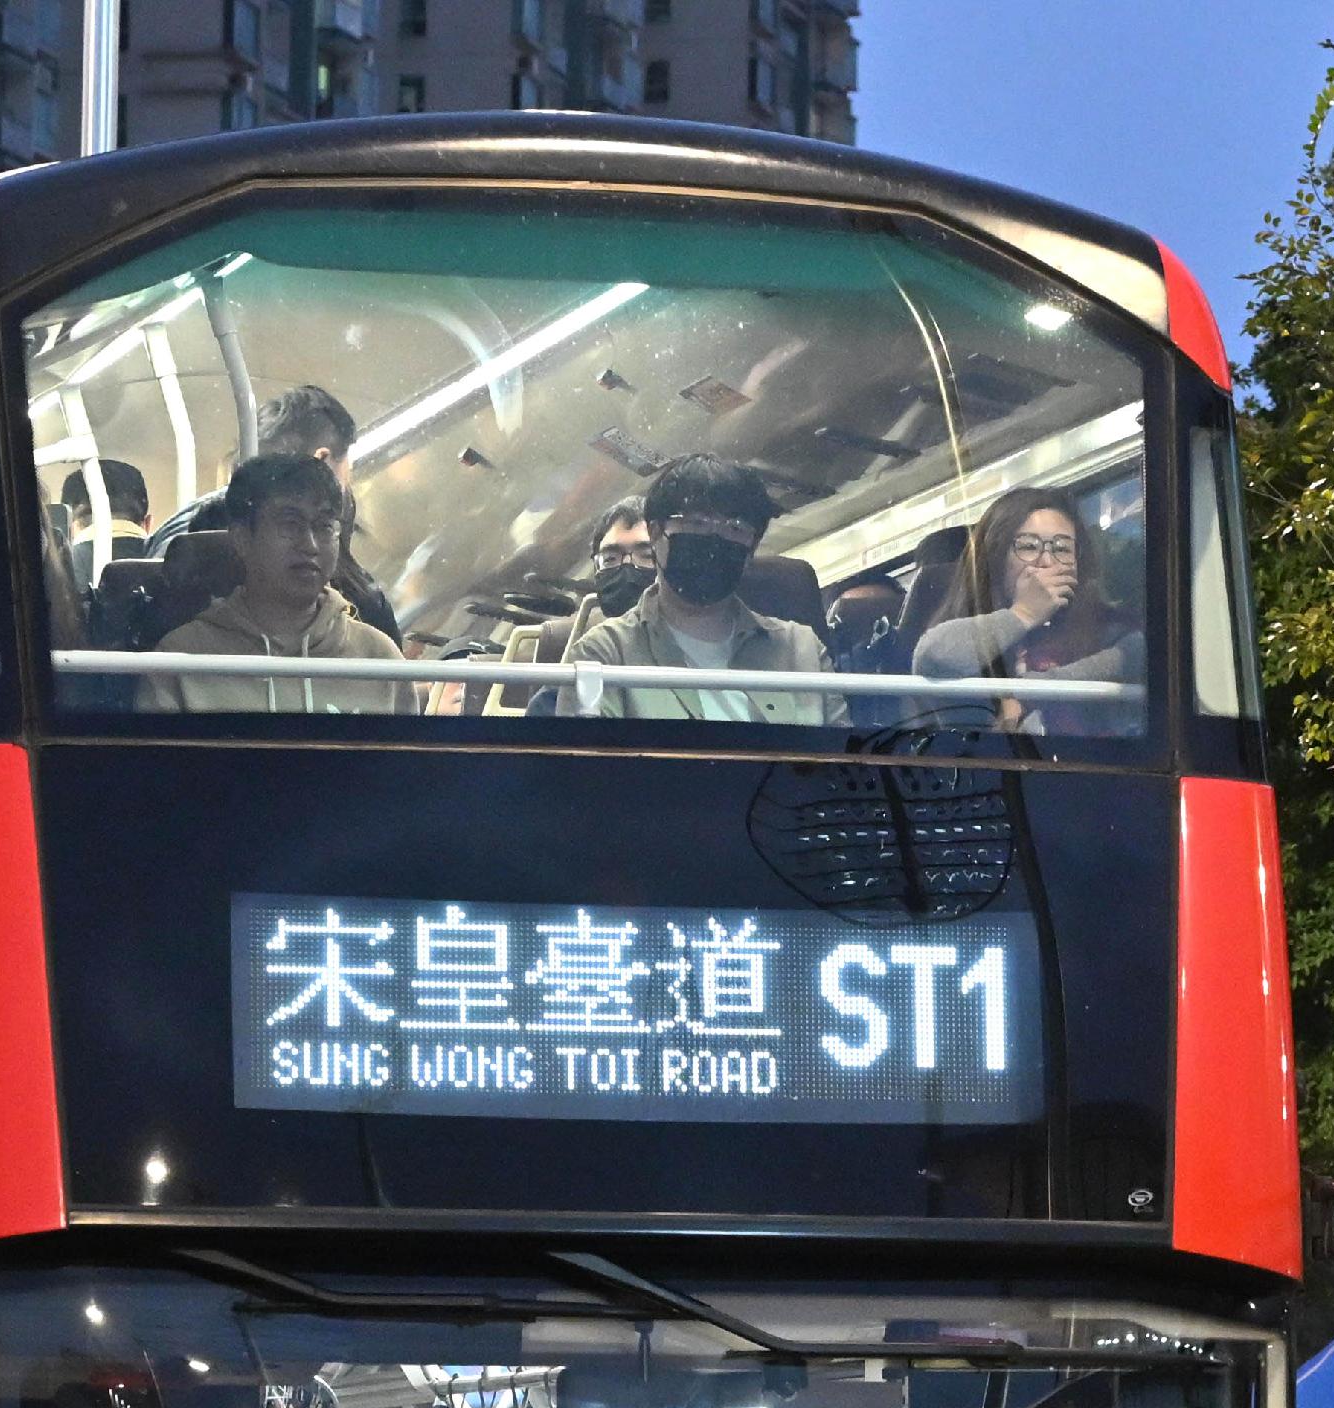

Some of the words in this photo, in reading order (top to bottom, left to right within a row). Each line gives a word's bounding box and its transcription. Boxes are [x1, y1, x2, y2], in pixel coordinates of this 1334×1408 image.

[266, 905, 782, 1036] 宋皇臺道
[819, 943, 1008, 1071] ST1
[272, 1042, 390, 1088] SUNG
[411, 1044, 534, 1090] WONG
[556, 1047, 641, 1092] TOI
[662, 1050, 777, 1094] ROAD
